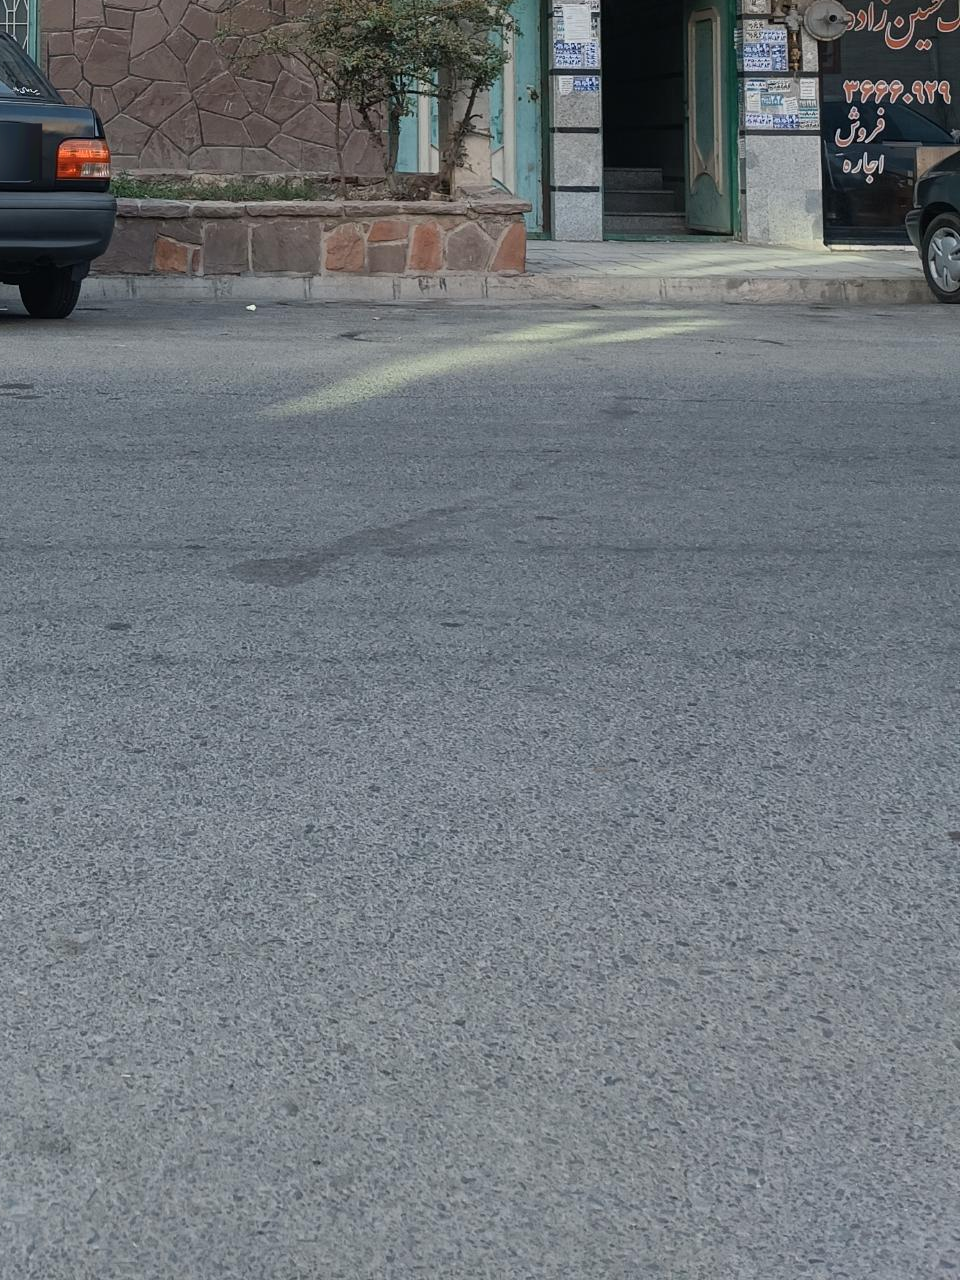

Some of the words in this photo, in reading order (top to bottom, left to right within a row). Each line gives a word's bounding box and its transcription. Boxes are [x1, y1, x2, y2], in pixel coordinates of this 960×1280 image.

[843, 79, 951, 105] ۳۶۶۶۰۹۲۹
[835, 106, 886, 147] فروش
[842, 151, 885, 184] اجاره
